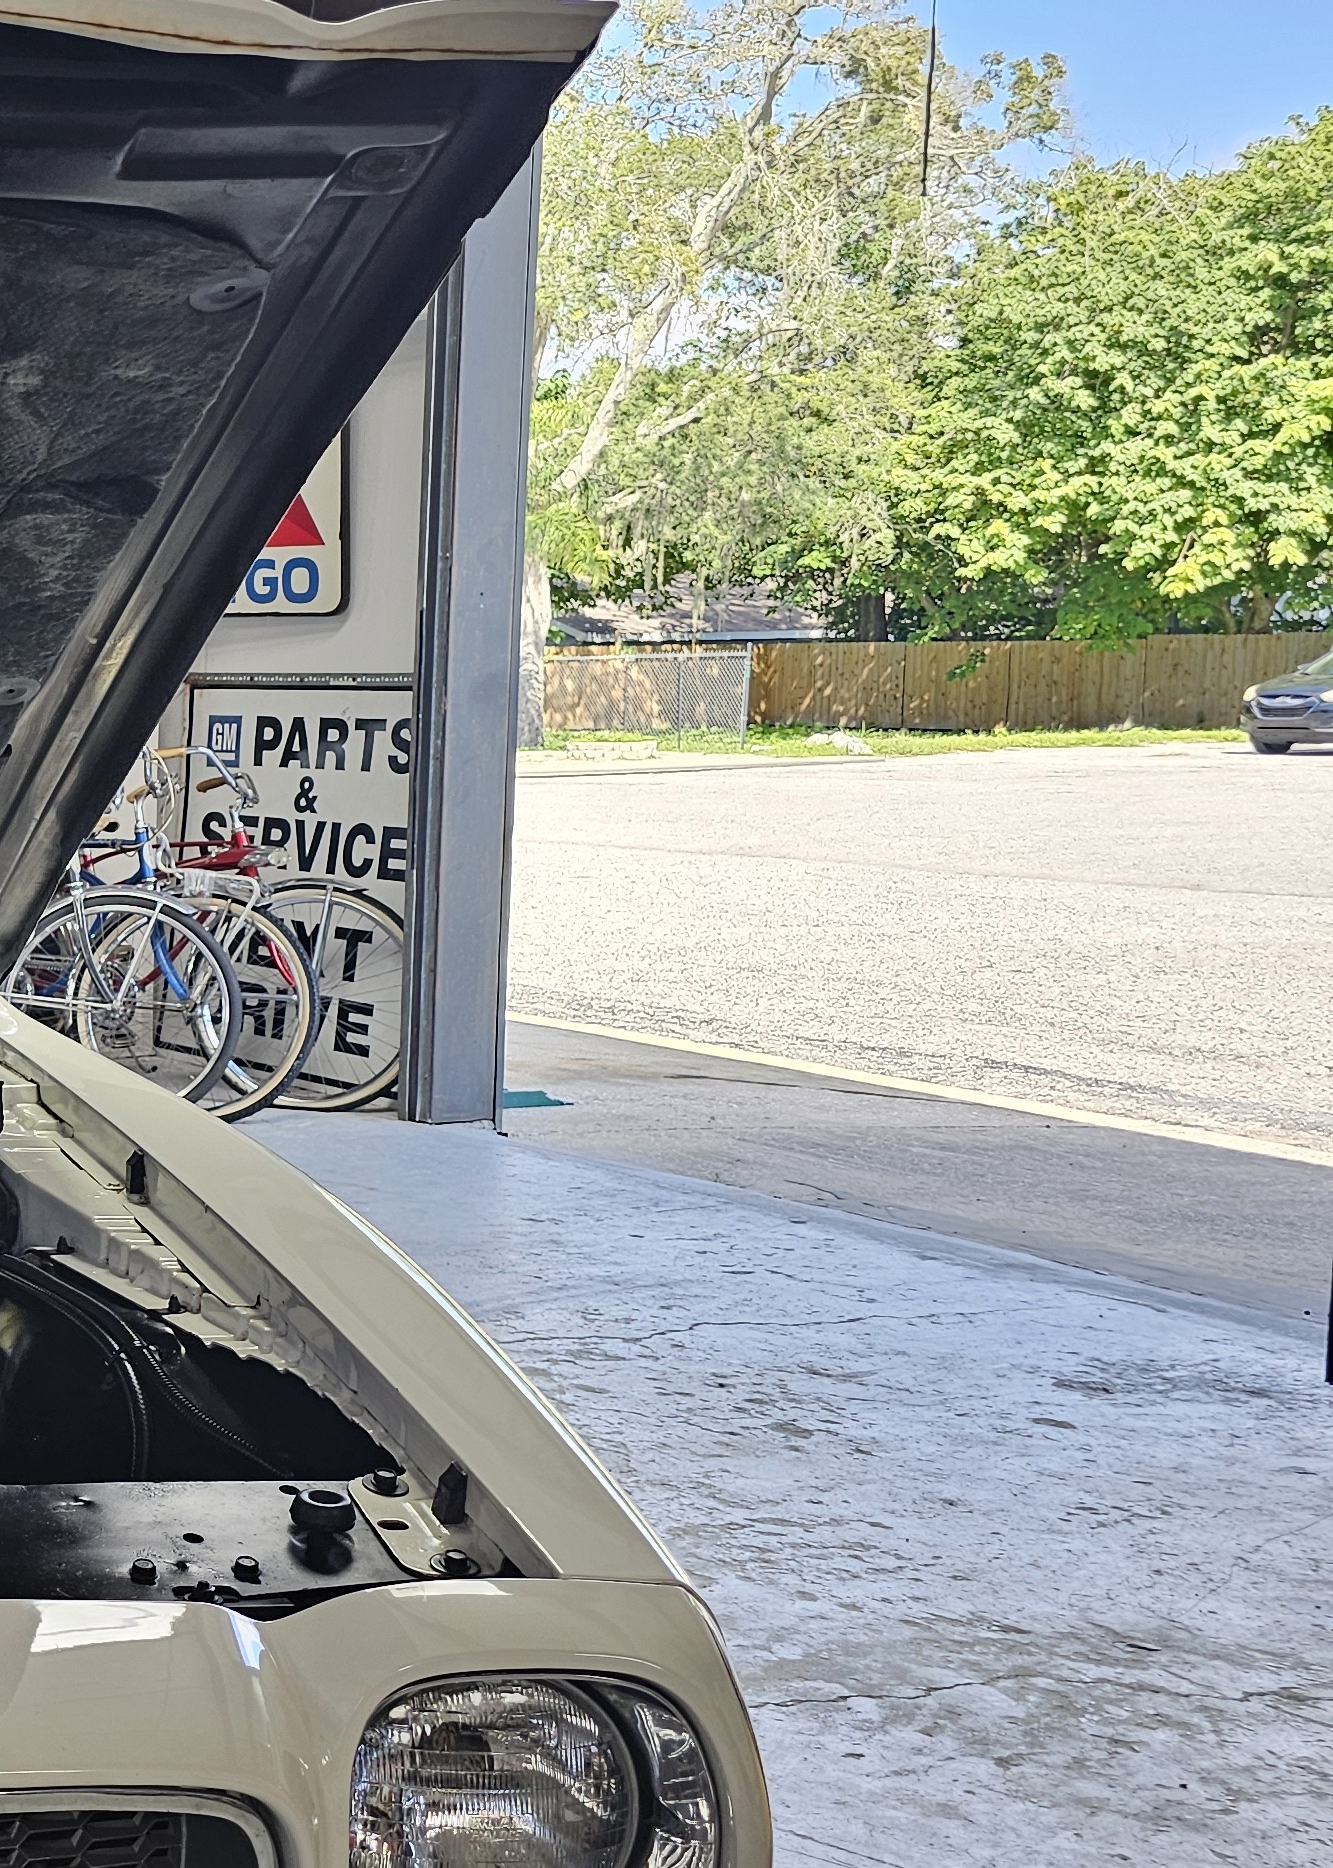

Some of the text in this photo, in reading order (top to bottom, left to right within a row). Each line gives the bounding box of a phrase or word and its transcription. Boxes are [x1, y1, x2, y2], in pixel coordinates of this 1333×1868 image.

[231, 557, 320, 605] GO
[211, 715, 412, 775] GM PARTS
[293, 775, 318, 814] &
